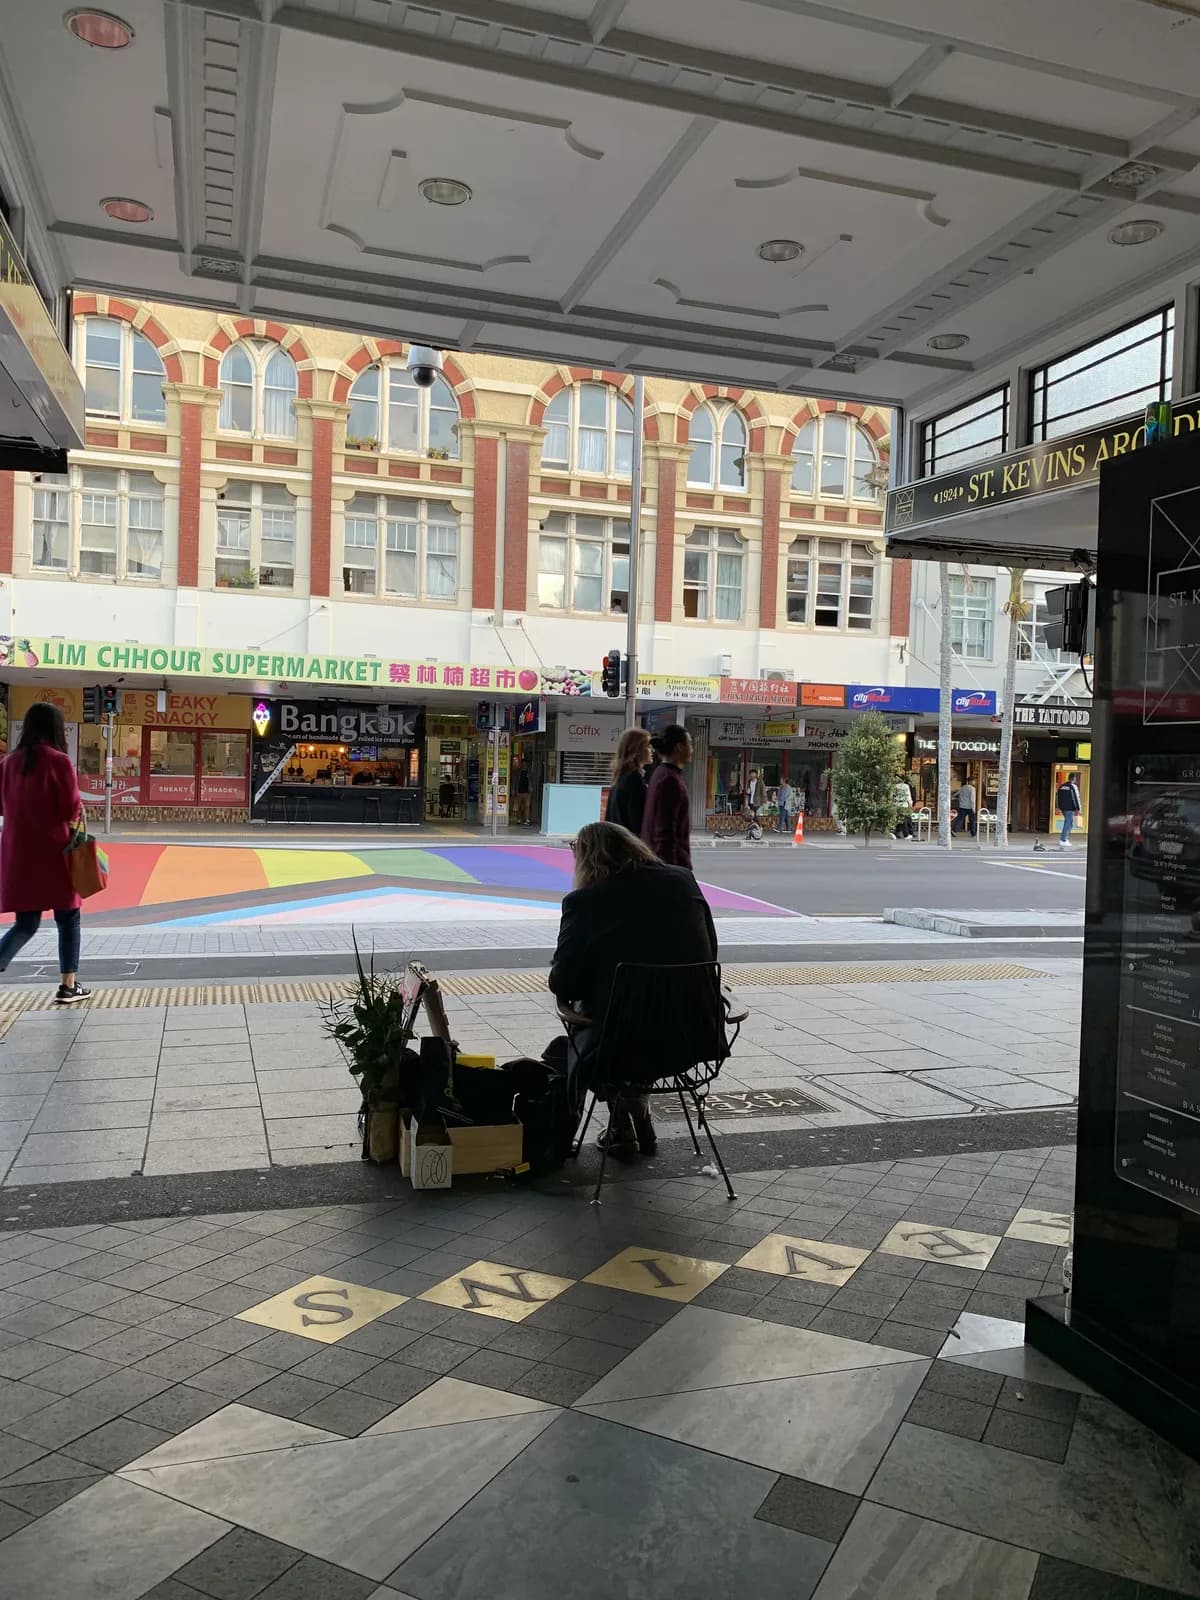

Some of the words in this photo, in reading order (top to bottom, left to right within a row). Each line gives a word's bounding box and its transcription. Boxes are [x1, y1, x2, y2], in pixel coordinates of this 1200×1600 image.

[939, 486, 958, 504] 1924
[967, 469, 996, 503] ST.
[1001, 443, 1086, 493] KEVINS
[42, 642, 87, 666] LIM
[97, 646, 201, 672] CHHOUR
[211, 652, 382, 682] SUPERMARKET
[636, 677, 657, 687] ourt
[145, 694, 217, 711] SEAKY
[144, 711, 218, 726] SNACKY
[280, 704, 415, 743] Bangkok
[1014, 706, 1036, 723] THE
[1038, 707, 1091, 726] TATTOOED
[568, 724, 600, 737] Coffix
[917, 739, 937, 750] THE
[951, 740, 988, 752] TTOOED
[660, 1098, 802, 1113] MYERS
